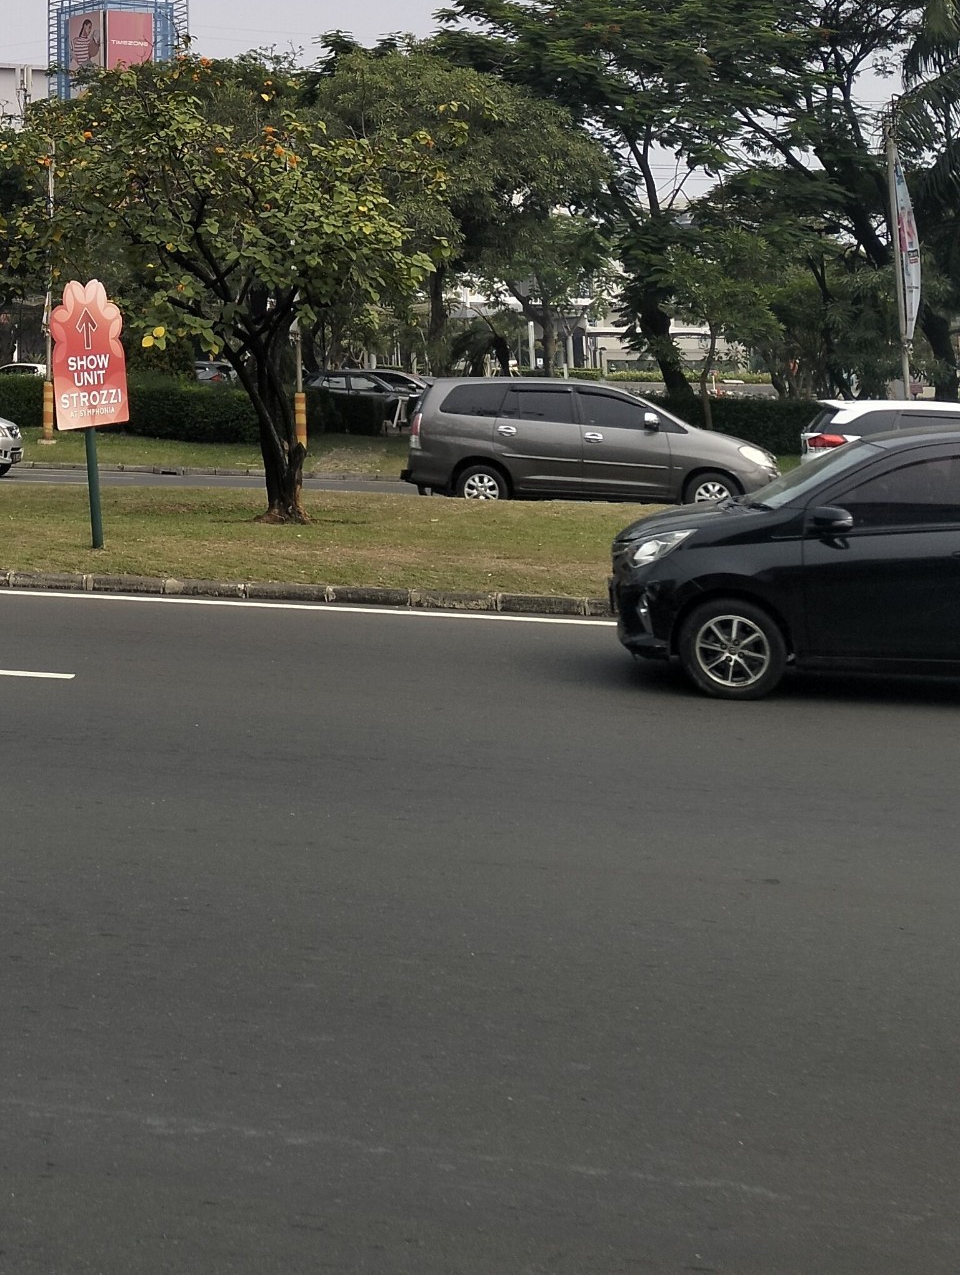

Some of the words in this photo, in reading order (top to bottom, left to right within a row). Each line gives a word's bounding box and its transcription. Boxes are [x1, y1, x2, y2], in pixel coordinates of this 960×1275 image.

[110, 39, 149, 47] TIMEZONE
[68, 354, 110, 371] SHOW
[74, 370, 106, 387] UNIT
[61, 389, 122, 409] STROZZI
[70, 410, 78, 419] AT
[79, 407, 115, 418] SYMPHONIA
